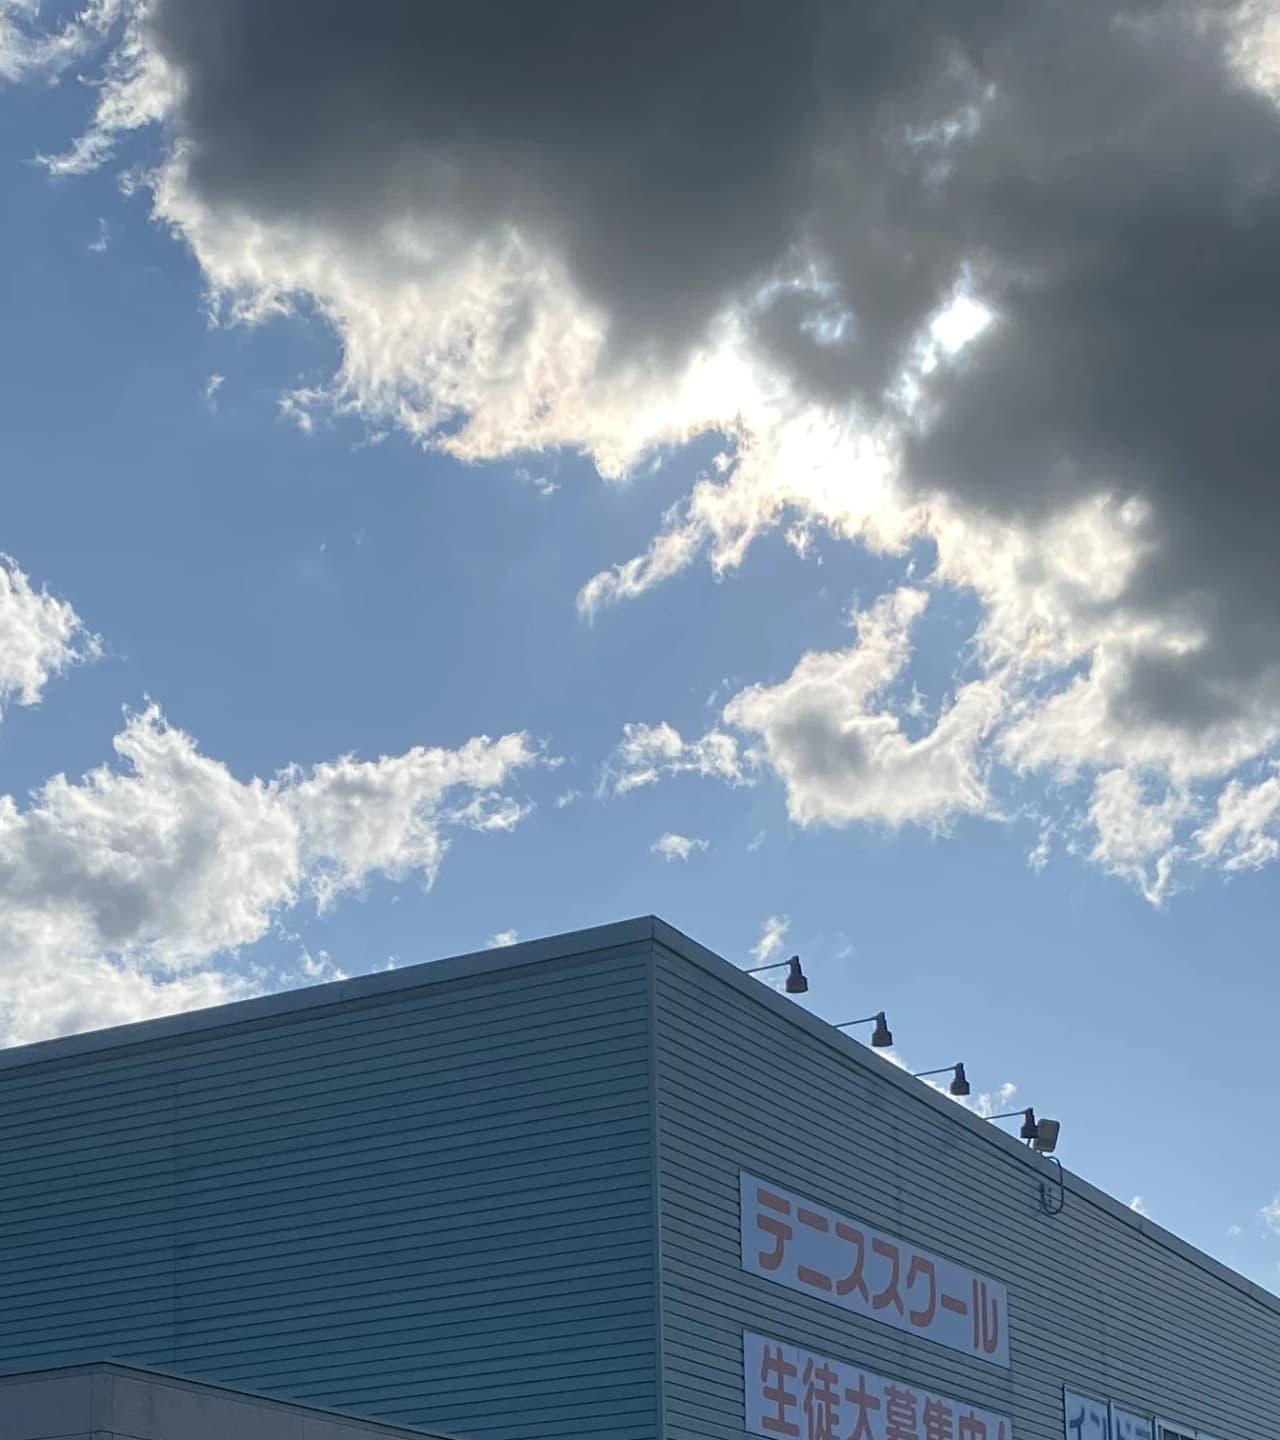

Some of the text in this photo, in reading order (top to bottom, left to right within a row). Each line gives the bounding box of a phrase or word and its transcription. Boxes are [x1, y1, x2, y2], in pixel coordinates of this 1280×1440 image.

[755, 1187, 999, 1355] テニススクール
